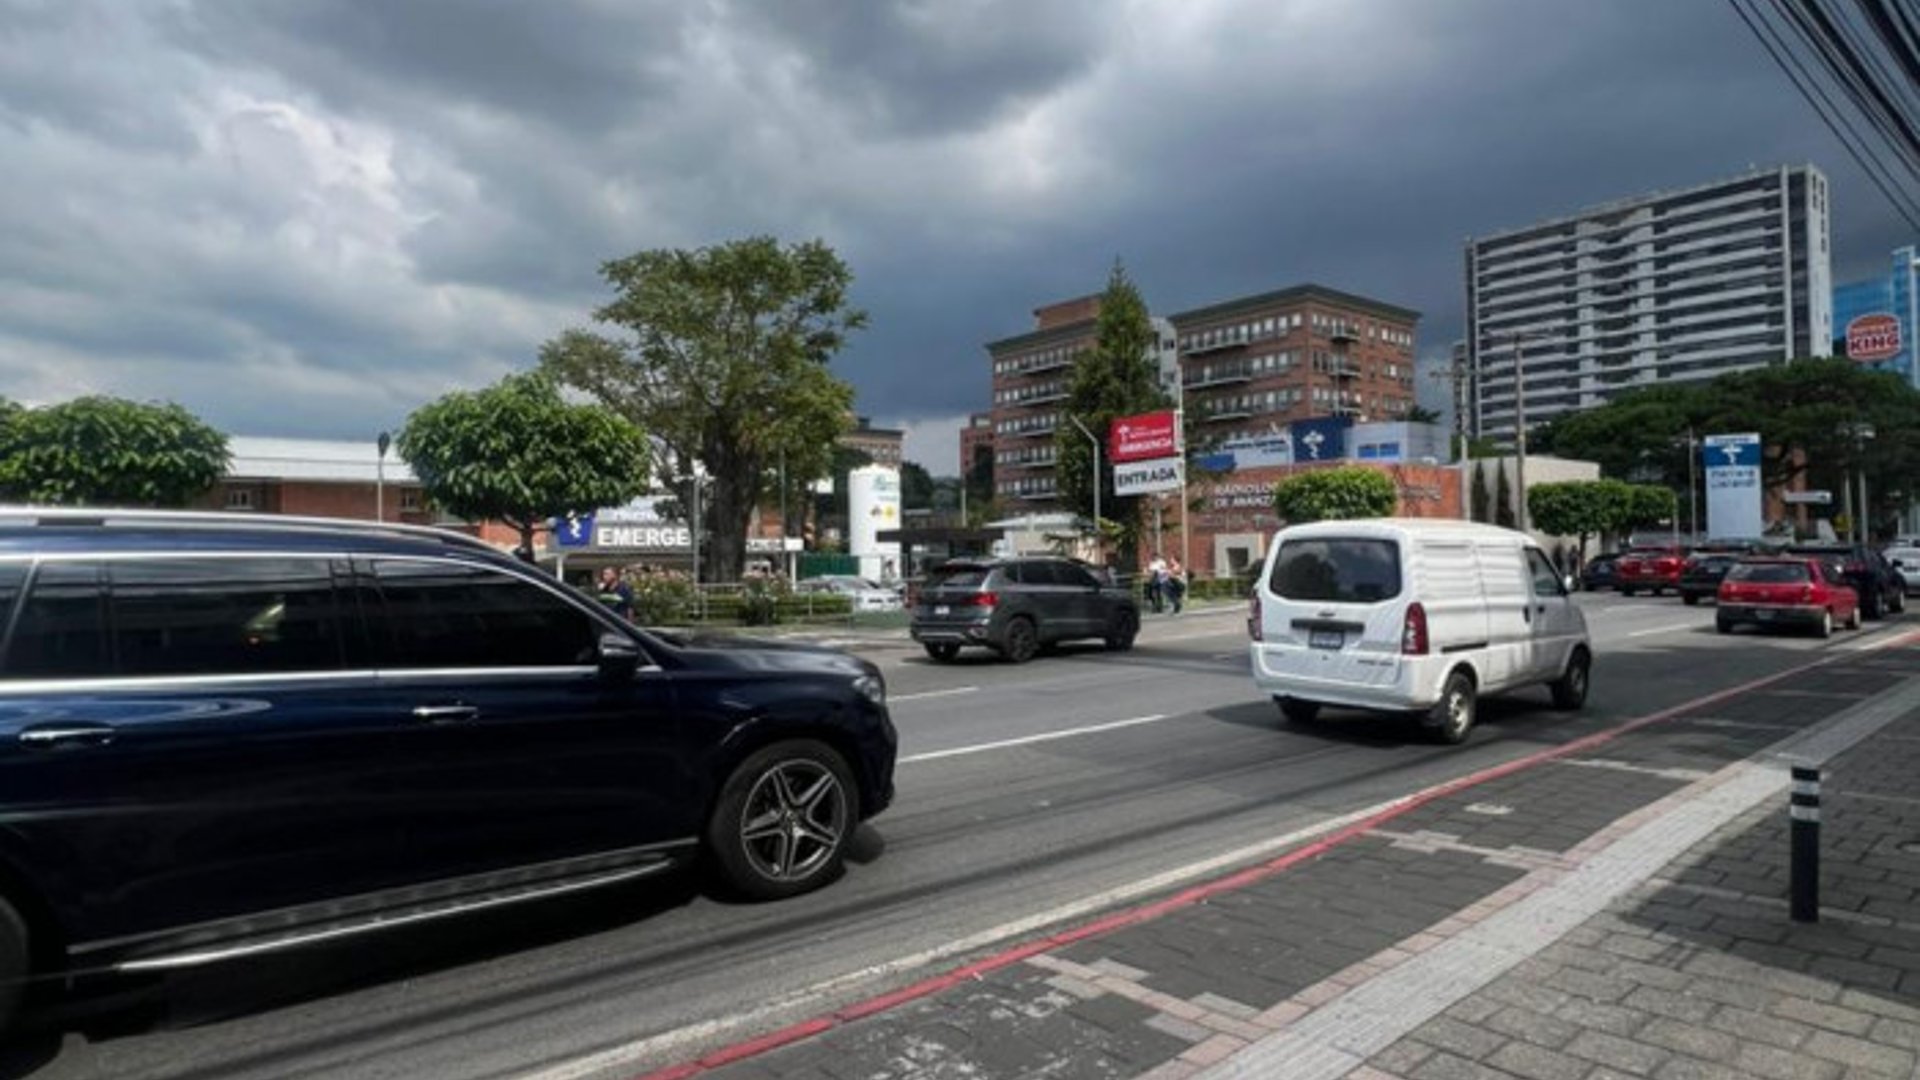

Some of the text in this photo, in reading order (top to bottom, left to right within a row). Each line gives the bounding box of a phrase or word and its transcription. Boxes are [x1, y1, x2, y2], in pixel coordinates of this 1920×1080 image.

[1850, 334, 1899, 352] KING
[1117, 467, 1177, 489] ENTRADA
[597, 528, 692, 548] EMERGE
